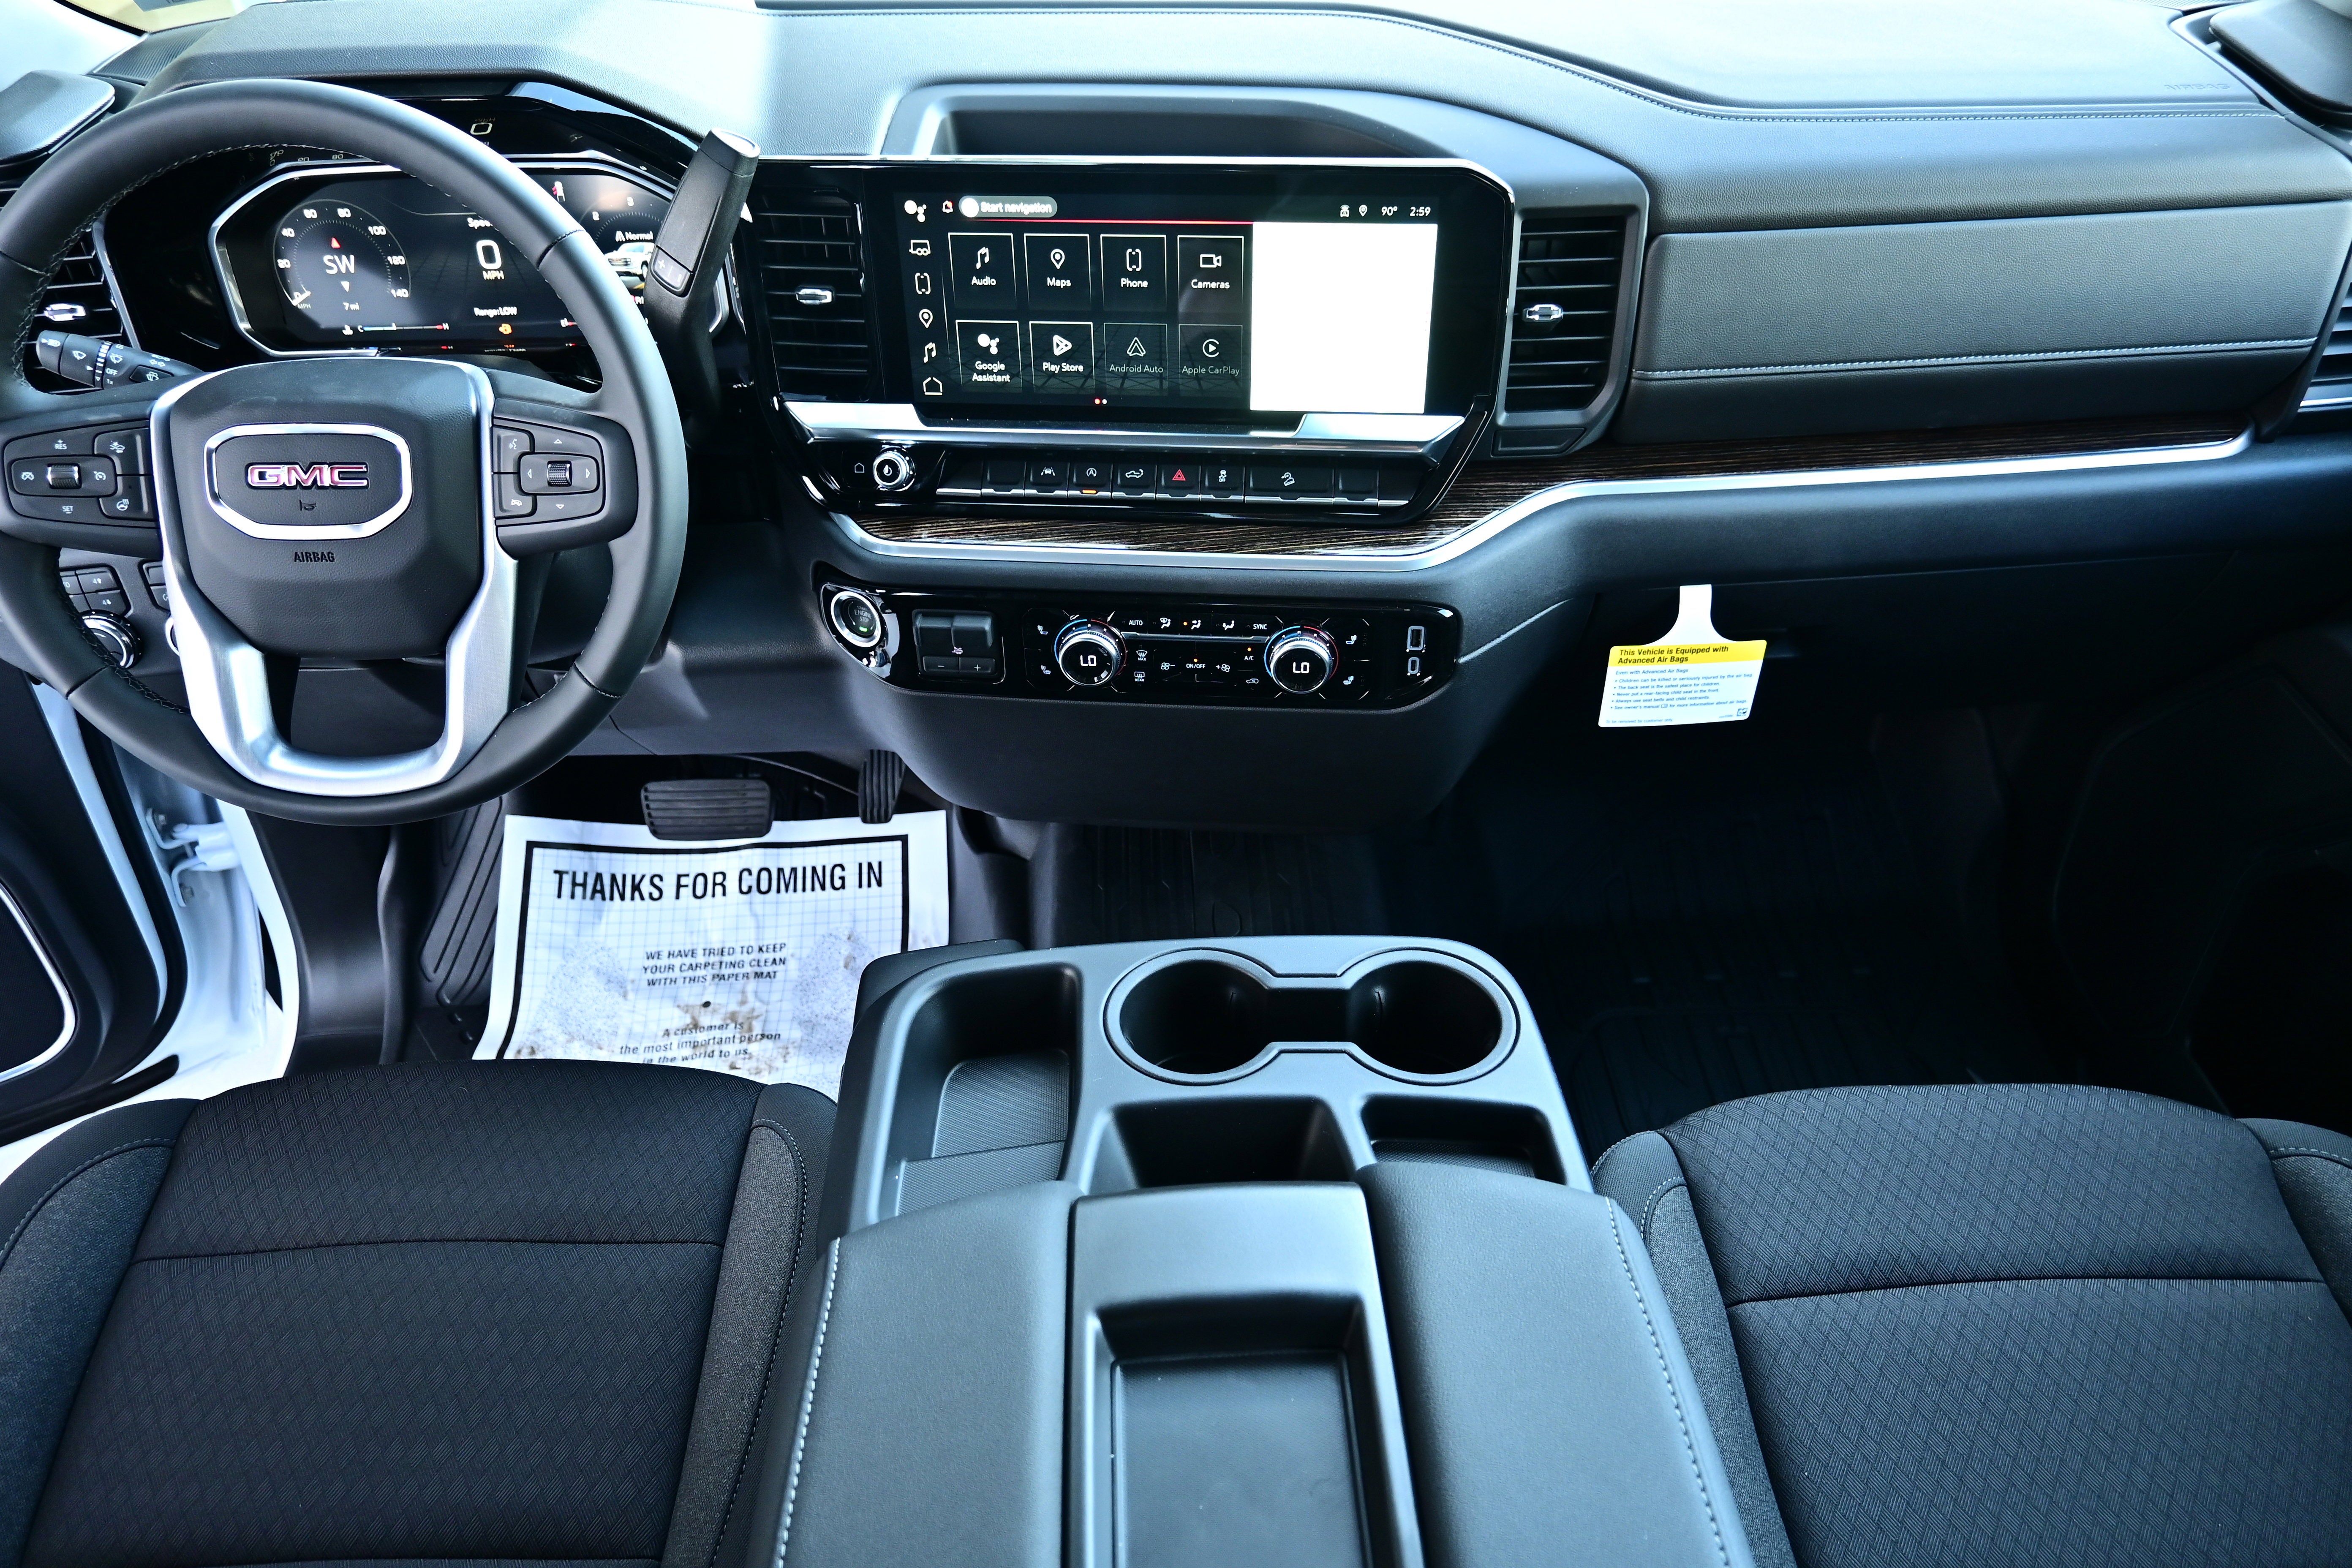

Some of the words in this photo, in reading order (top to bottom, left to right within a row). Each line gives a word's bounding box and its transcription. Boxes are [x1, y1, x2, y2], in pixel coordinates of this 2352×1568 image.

[980, 202, 1004, 212] Start
[1004, 202, 1052, 215] navigation
[1410, 206, 1431, 217] 2:59
[281, 228, 295, 237] 40
[368, 226, 386, 235] 100
[625, 231, 653, 240] Normal
[387, 256, 406, 265] 120
[476, 240, 502, 270] 0
[277, 259, 291, 268] 20
[323, 255, 355, 274] SW
[483, 271, 504, 280] MPH
[971, 276, 996, 286] Audio
[1047, 278, 1071, 288] Maps
[1121, 278, 1148, 288] Phone
[1191, 279, 1230, 290] Cameras
[391, 289, 409, 298] 140
[975, 362, 1005, 372] Google
[1043, 362, 1060, 373] Play
[1062, 363, 1083, 373] Store
[1109, 364, 1142, 373] Android
[1144, 365, 1163, 373] Auto
[1182, 365, 1207, 376] Apple
[1209, 365, 1240, 377] CarPlay
[972, 373, 1010, 382] Assistant
[248, 464, 368, 487] GMC
[294, 552, 335, 563] AIRBAG
[854, 610, 871, 619] ENGINE
[1676, 647, 1710, 655] Equipped
[553, 869, 664, 901] THANKS
[675, 871, 727, 900] FOR
[738, 863, 846, 895] COMING
[858, 860, 882, 888] IN
[645, 950, 664, 961] WE
[667, 948, 697, 959] HAVE
[702, 947, 735, 957] TRIED
[740, 945, 754, 955] TO
[757, 942, 787, 954] KEEP
[643, 964, 675, 975] YOUR
[679, 960, 745, 972] CARPETING
[749, 957, 787, 968] CLEAN
[647, 977, 677, 987] WITH
[682, 974, 707, 984] THIS
[711, 972, 750, 982] PAPER
[753, 970, 779, 980] MAT
[662, 1029, 670, 1038] A
[674, 1022, 730, 1037] customer
[620, 1045, 639, 1055] the
[643, 1042, 672, 1054] most
[677, 1034, 735, 1050] important
[740, 1033, 781, 1043] person
[658, 1054, 677, 1064] the
[681, 1050, 714, 1062] world
[719, 1050, 730, 1058] to
